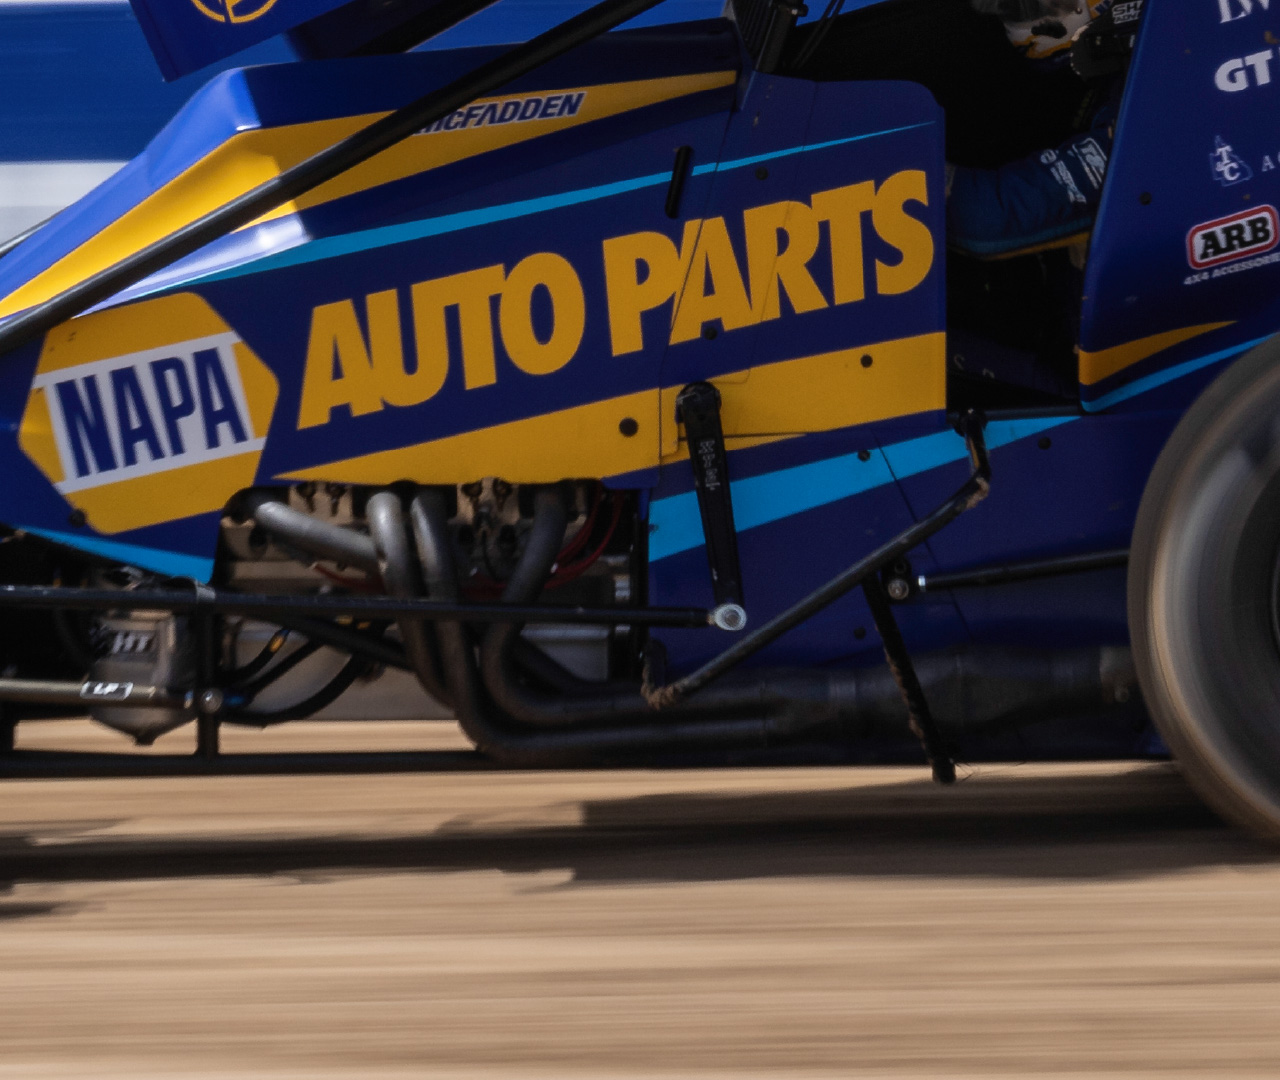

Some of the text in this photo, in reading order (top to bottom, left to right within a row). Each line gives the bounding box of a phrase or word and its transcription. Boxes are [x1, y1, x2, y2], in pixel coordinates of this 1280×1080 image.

[1214, 50, 1273, 92] GT
[1261, 156, 1275, 172] A
[1199, 215, 1271, 261] ARB
[297, 169, 935, 429] AUTO PARTS
[53, 346, 249, 479] NAPA
